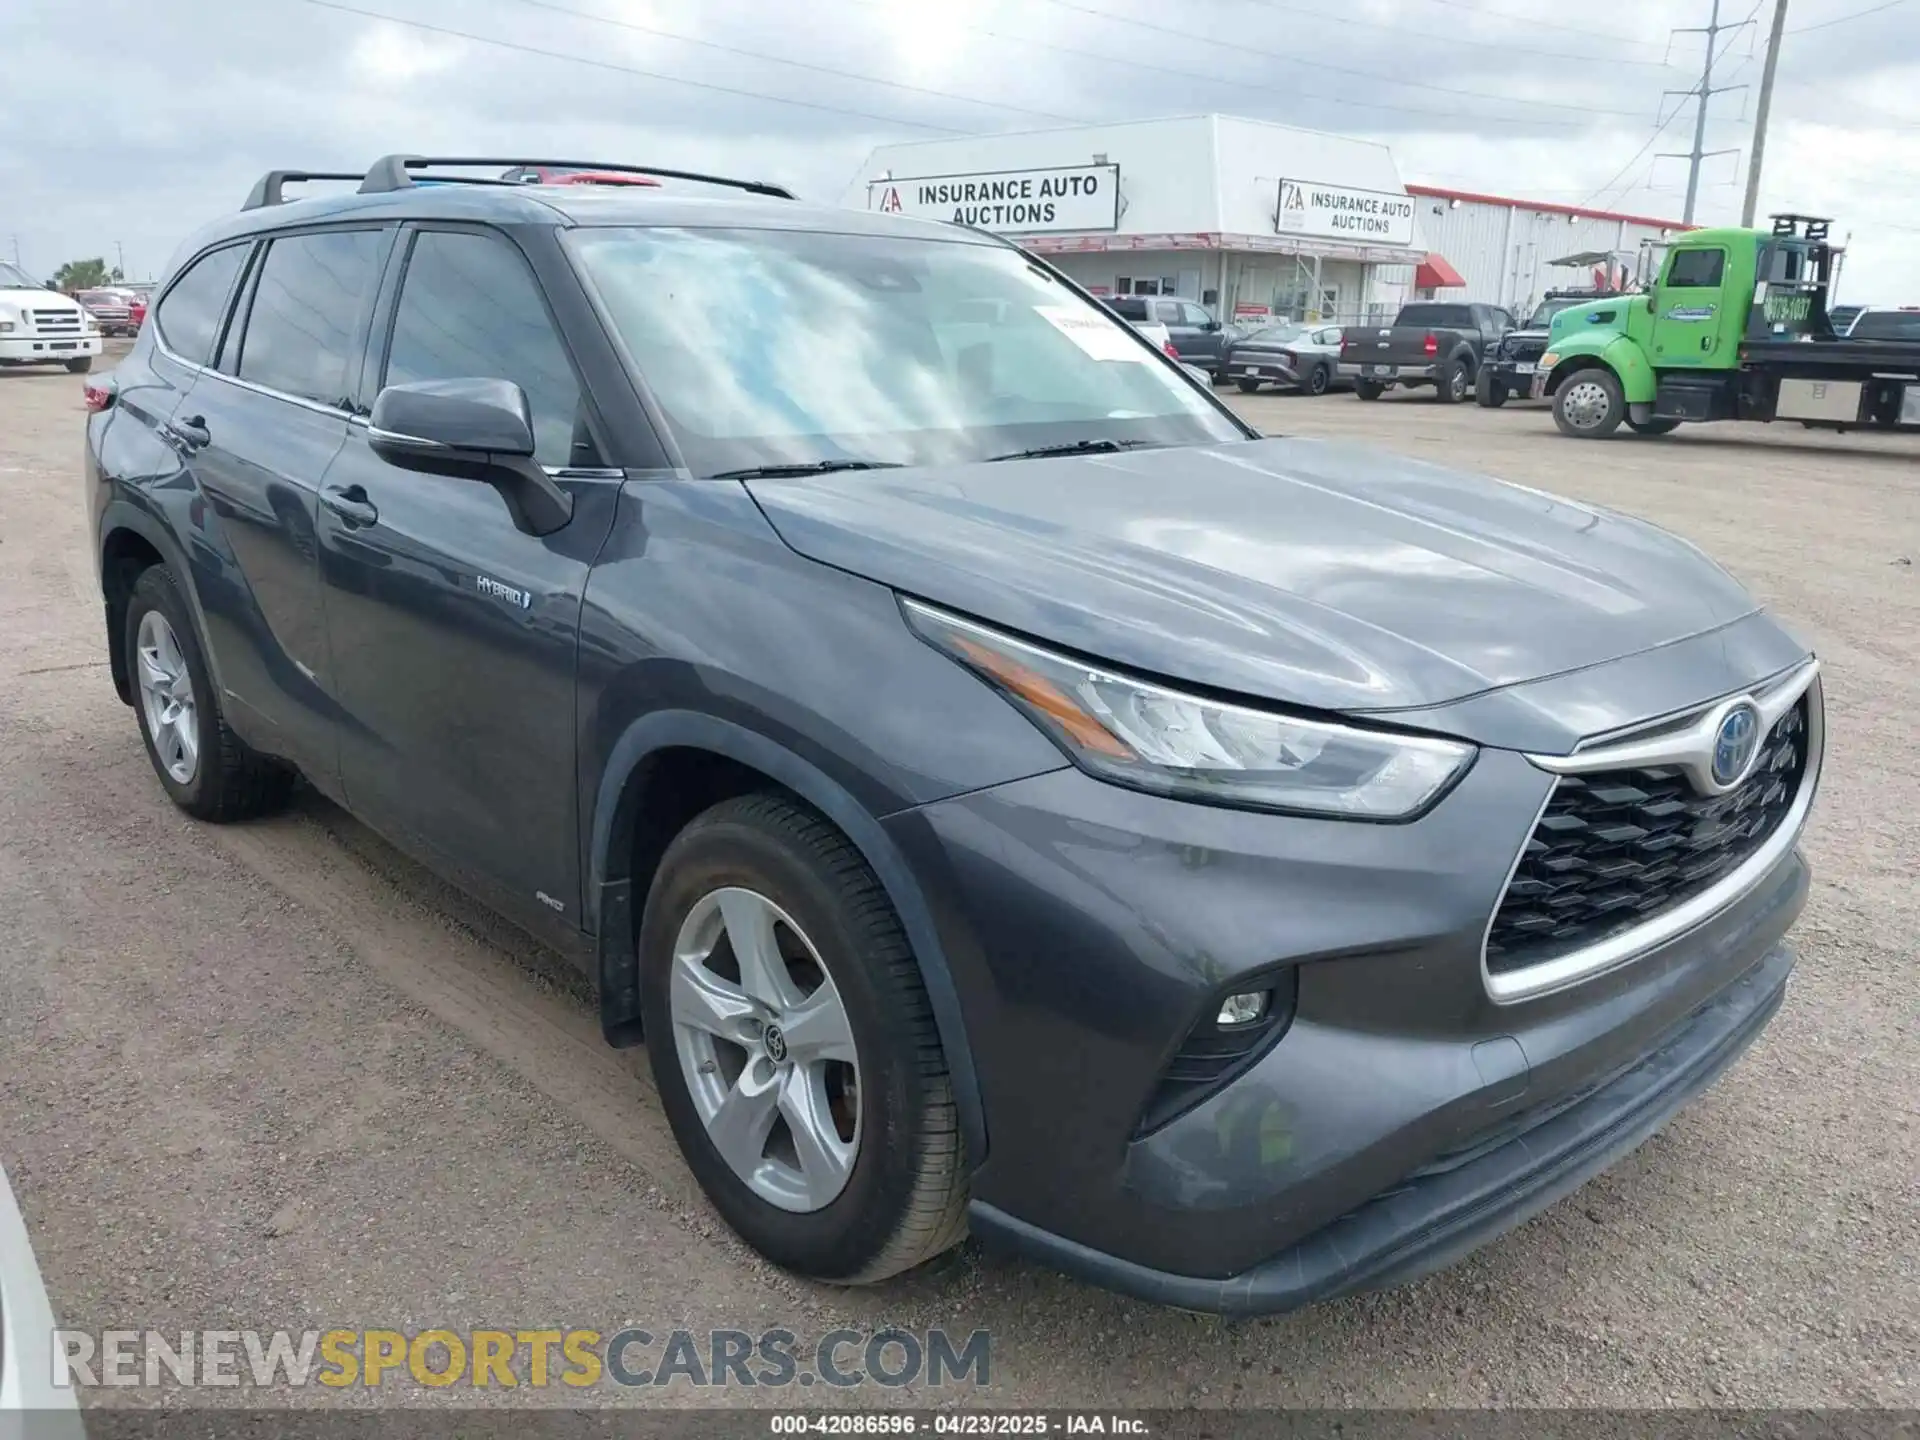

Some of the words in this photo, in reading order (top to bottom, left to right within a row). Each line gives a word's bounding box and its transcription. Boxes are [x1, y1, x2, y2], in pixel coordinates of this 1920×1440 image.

[918, 179, 1032, 205] INSURANCE
[1039, 175, 1098, 197] AUTO
[952, 202, 1056, 225] AUCTIONS
[1311, 192, 1379, 214] INSURANCE
[1381, 202, 1411, 218] AUTO
[1331, 214, 1390, 233] AUCTIONS
[476, 575, 522, 606] HYBRID
